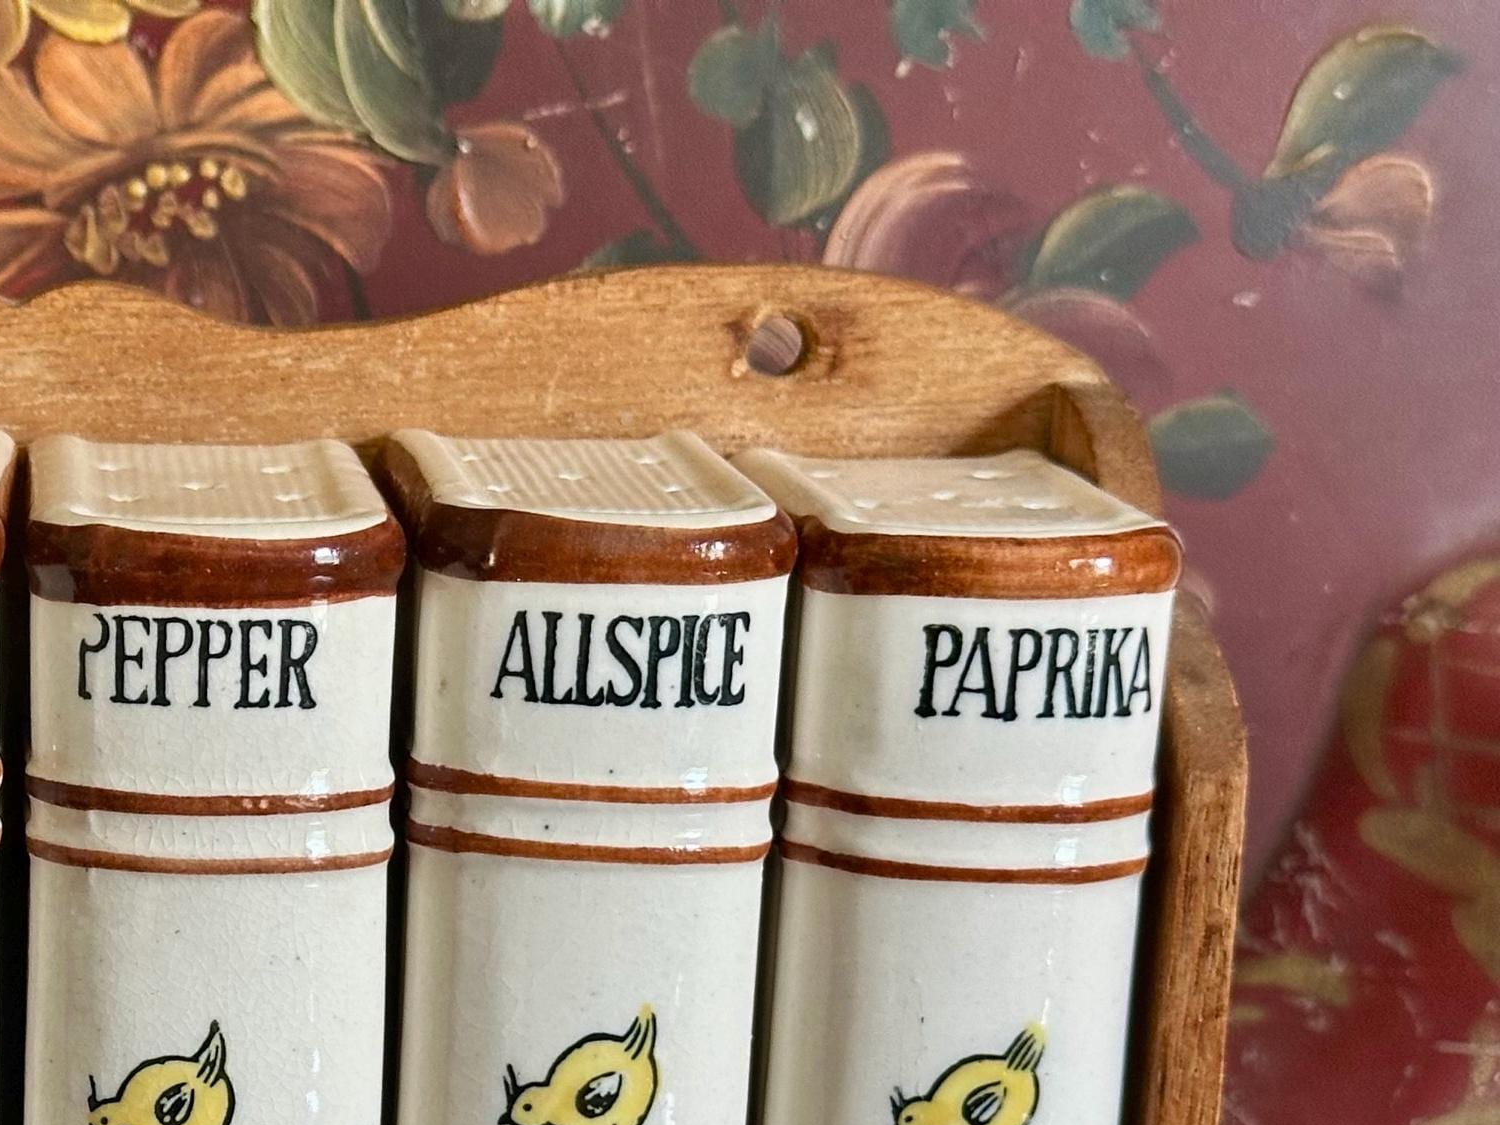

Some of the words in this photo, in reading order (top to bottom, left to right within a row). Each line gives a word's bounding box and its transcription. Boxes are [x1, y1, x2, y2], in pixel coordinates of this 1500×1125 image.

[77, 612, 319, 710] PEPPER
[489, 609, 752, 710] ALLSPICE
[913, 623, 1153, 723] PAPRIKA
